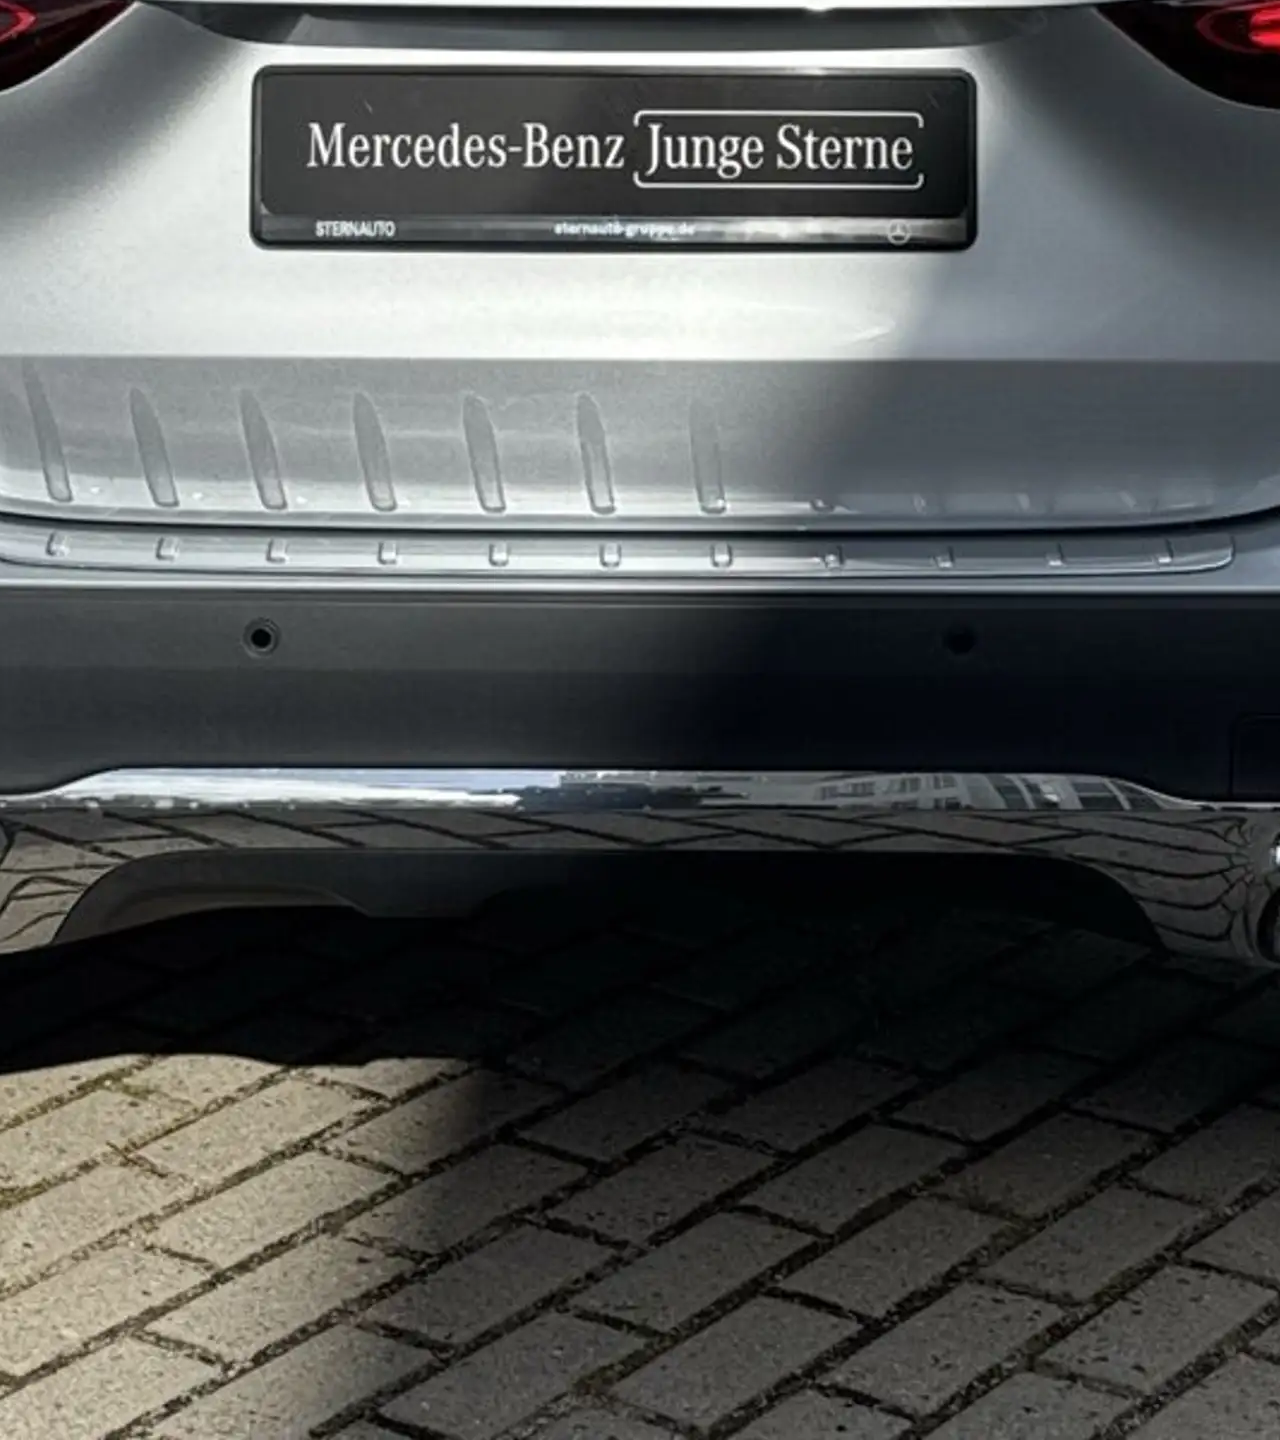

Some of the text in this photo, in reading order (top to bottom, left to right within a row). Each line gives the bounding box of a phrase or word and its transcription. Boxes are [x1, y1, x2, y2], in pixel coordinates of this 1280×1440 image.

[306, 122, 914, 180] Mercedes-Benz Junge Sterne
[315, 220, 397, 238] STERNAUTO
